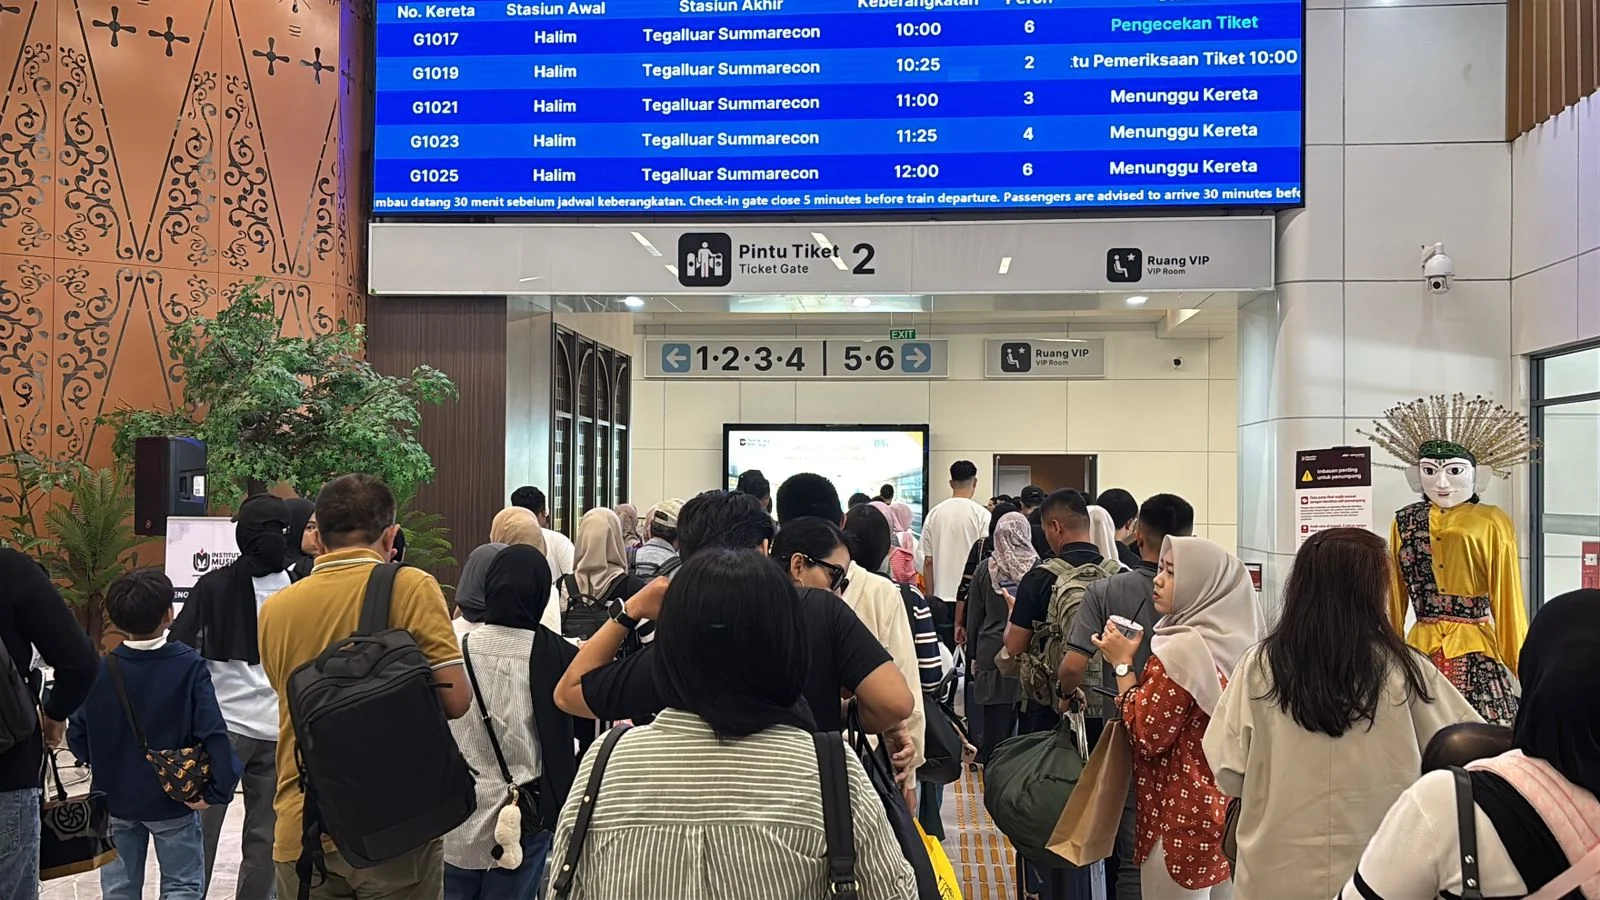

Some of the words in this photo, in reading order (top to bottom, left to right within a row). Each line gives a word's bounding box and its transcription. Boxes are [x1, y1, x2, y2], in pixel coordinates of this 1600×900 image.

[397, 6, 421, 19] No.
[426, 5, 475, 18] Kereta
[506, 3, 564, 16] Stasiun
[568, 2, 606, 15] Awal
[679, 0, 738, 13] Stasiun
[742, 0, 783, 11] Akhir
[896, 23, 942, 36] 10:00
[1024, 20, 1035, 34] 6
[1111, 17, 1212, 35] Pengecekan
[1216, 16, 1259, 30] Tiket
[413, 33, 459, 46] G1017
[535, 30, 577, 44] Halim
[643, 28, 716, 45] Tegalluar
[719, 28, 821, 41] Summarecon
[896, 58, 941, 71] 10:25
[1024, 56, 1035, 69] 2
[1070, 56, 1090, 68] tu
[1093, 53, 1199, 67] Pemeriksaan
[1203, 52, 1246, 66] Tiket
[1250, 50, 1298, 65] 10:00
[412, 67, 459, 80] G1019
[534, 65, 577, 78] Halim
[642, 63, 715, 80] Tegalluar
[718, 63, 820, 76] Summarecon
[896, 94, 939, 107] 11:00
[1023, 92, 1034, 105] 3
[1110, 90, 1199, 105] Menunggu
[1203, 88, 1258, 102] Kereta
[412, 101, 458, 114] G1021
[534, 99, 577, 113] Halim
[642, 98, 714, 115] Tegalluar
[718, 98, 820, 111] Summarecon
[896, 129, 938, 142] 11:25
[1023, 127, 1034, 140] 4
[1110, 126, 1199, 141] Menunggu
[1203, 124, 1258, 137] Kereta
[411, 135, 460, 148] G1023
[533, 134, 577, 147] Halim
[642, 133, 714, 150] Tegalluar
[718, 133, 820, 146] Summarecon
[894, 165, 939, 178] 12:00
[1022, 163, 1033, 176] 6
[1109, 162, 1199, 177] Menunggu
[1203, 160, 1258, 174] Kereta
[410, 170, 459, 183] G1025
[533, 169, 576, 182] Halim
[641, 168, 714, 185] Tegalluar
[717, 168, 819, 181] Summarecon
[375, 197, 408, 208] mbau
[411, 197, 450, 209] datang
[454, 197, 468, 207] 30
[471, 197, 504, 207] menit
[507, 197, 555, 207] sebelum
[557, 197, 595, 210] jadwal
[597, 196, 687, 210] keberangkatan.
[689, 195, 740, 206] Check-in
[742, 197, 768, 209] gate
[771, 195, 801, 206] close
[804, 195, 811, 205] 5
[814, 194, 861, 205] minutes
[864, 194, 904, 204] before
[906, 193, 935, 204] train
[937, 193, 1001, 206] departure.
[1003, 192, 1071, 205] Passengers
[1075, 193, 1095, 201] are
[1097, 190, 1144, 201] advised
[1147, 190, 1161, 200] to
[1164, 189, 1200, 200] arrive
[1204, 189, 1219, 199] 30
[1222, 188, 1273, 199] minutes
[739, 244, 787, 259] Pintu
[792, 244, 840, 259] Tiket
[852, 243, 876, 275] 2
[1147, 255, 1186, 268] Ruang
[1189, 255, 1210, 266] VIP
[739, 263, 778, 274] Ticket
[780, 263, 809, 274] Gate
[891, 330, 914, 340] EXIT
[1035, 349, 1069, 359] Ruang
[1071, 348, 1089, 358] VIP
